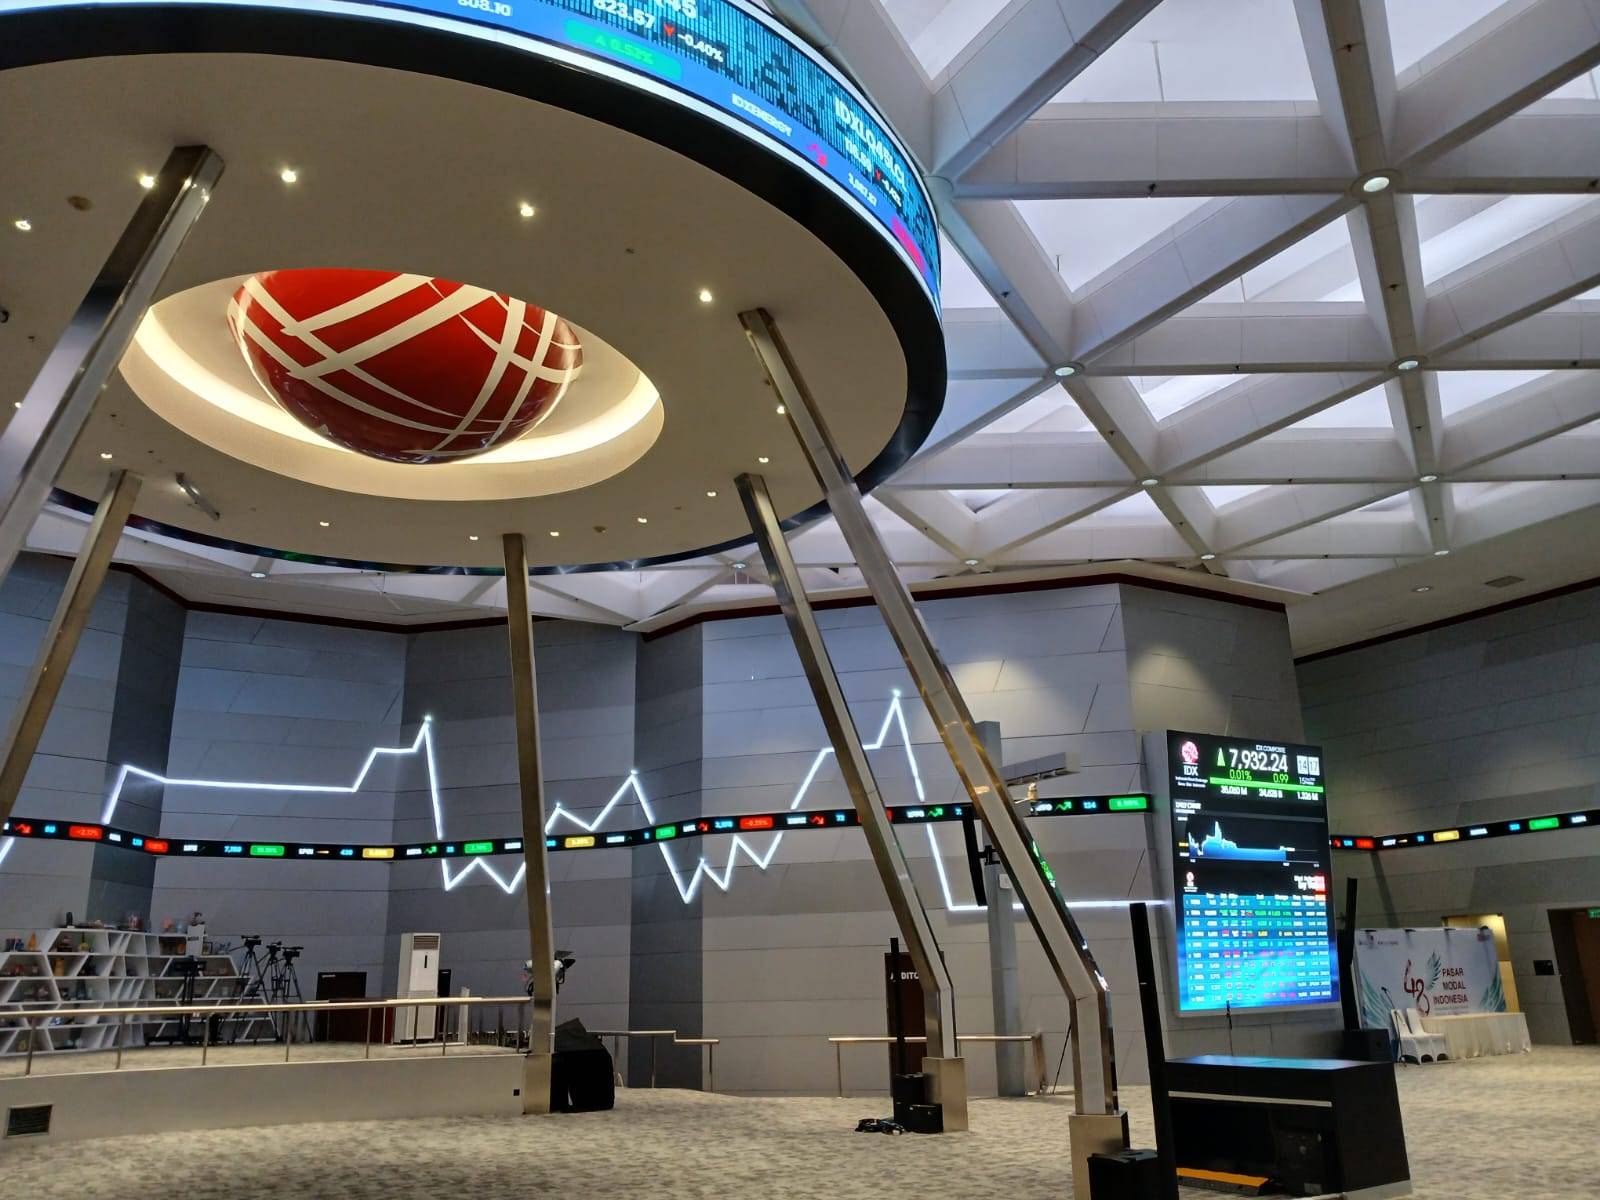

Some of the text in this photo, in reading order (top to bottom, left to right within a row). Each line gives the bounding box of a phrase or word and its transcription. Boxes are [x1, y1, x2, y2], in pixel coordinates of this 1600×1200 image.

[1229, 749, 1288, 773] 7,932.24
[1183, 765, 1199, 776] IDX
[1229, 769, 1252, 781] 0.01%
[1273, 773, 1289, 784] 0.99
[1442, 968, 1464, 977] PASAR
[1442, 981, 1467, 990] MODAL
[1433, 995, 1469, 1005] INDONESIA
